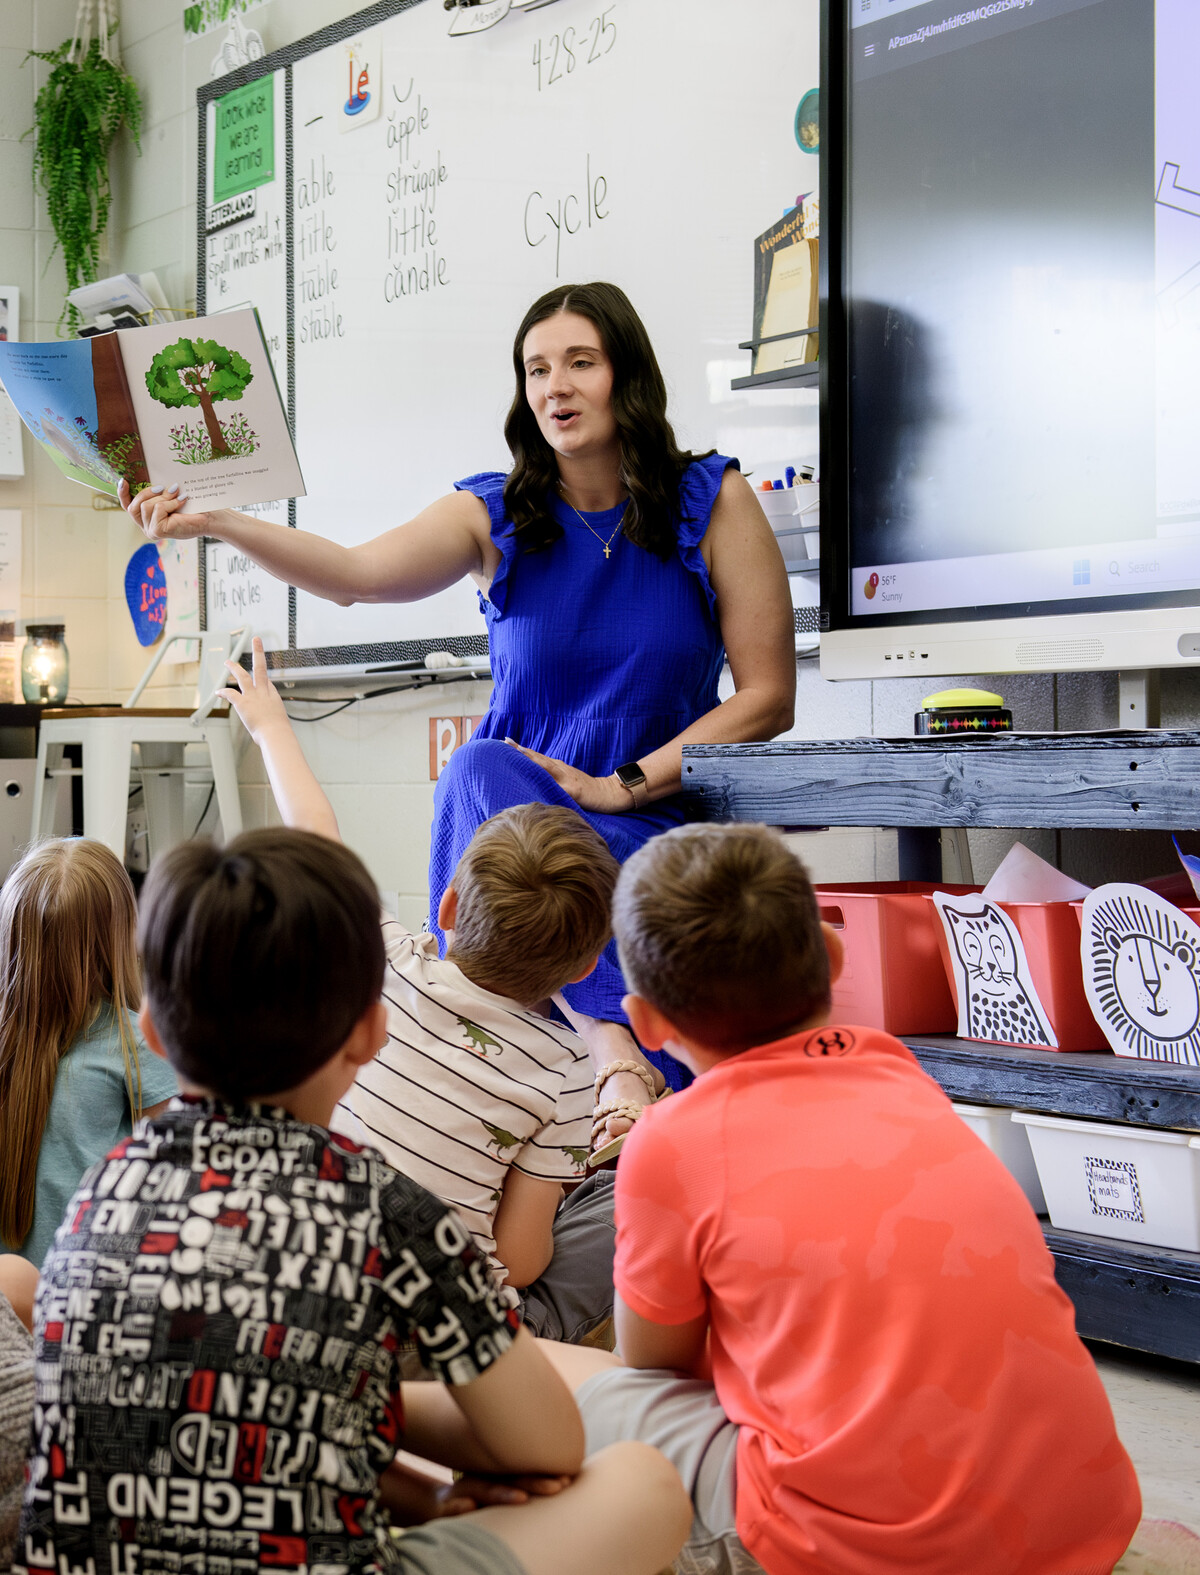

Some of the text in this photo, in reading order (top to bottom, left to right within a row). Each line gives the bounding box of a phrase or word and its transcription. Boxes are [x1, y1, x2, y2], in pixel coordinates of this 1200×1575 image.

[533, 4, 616, 91] 4-28-25
[207, 194, 253, 226] LETTERLAND
[524, 153, 610, 278] Cycle
[224, 229, 241, 252] can
[244, 210, 269, 243] read
[208, 232, 284, 286] spell words with
[211, 548, 218, 572] I
[1128, 559, 1161, 574] Search
[212, 578, 228, 612] life
[881, 574, 897, 586] 56°F
[881, 591, 903, 603] Sunny
[209, 1142, 301, 1177] GOAT
[1098, 1184, 1120, 1199] mats
[106, 1473, 304, 1534] LEGEND
